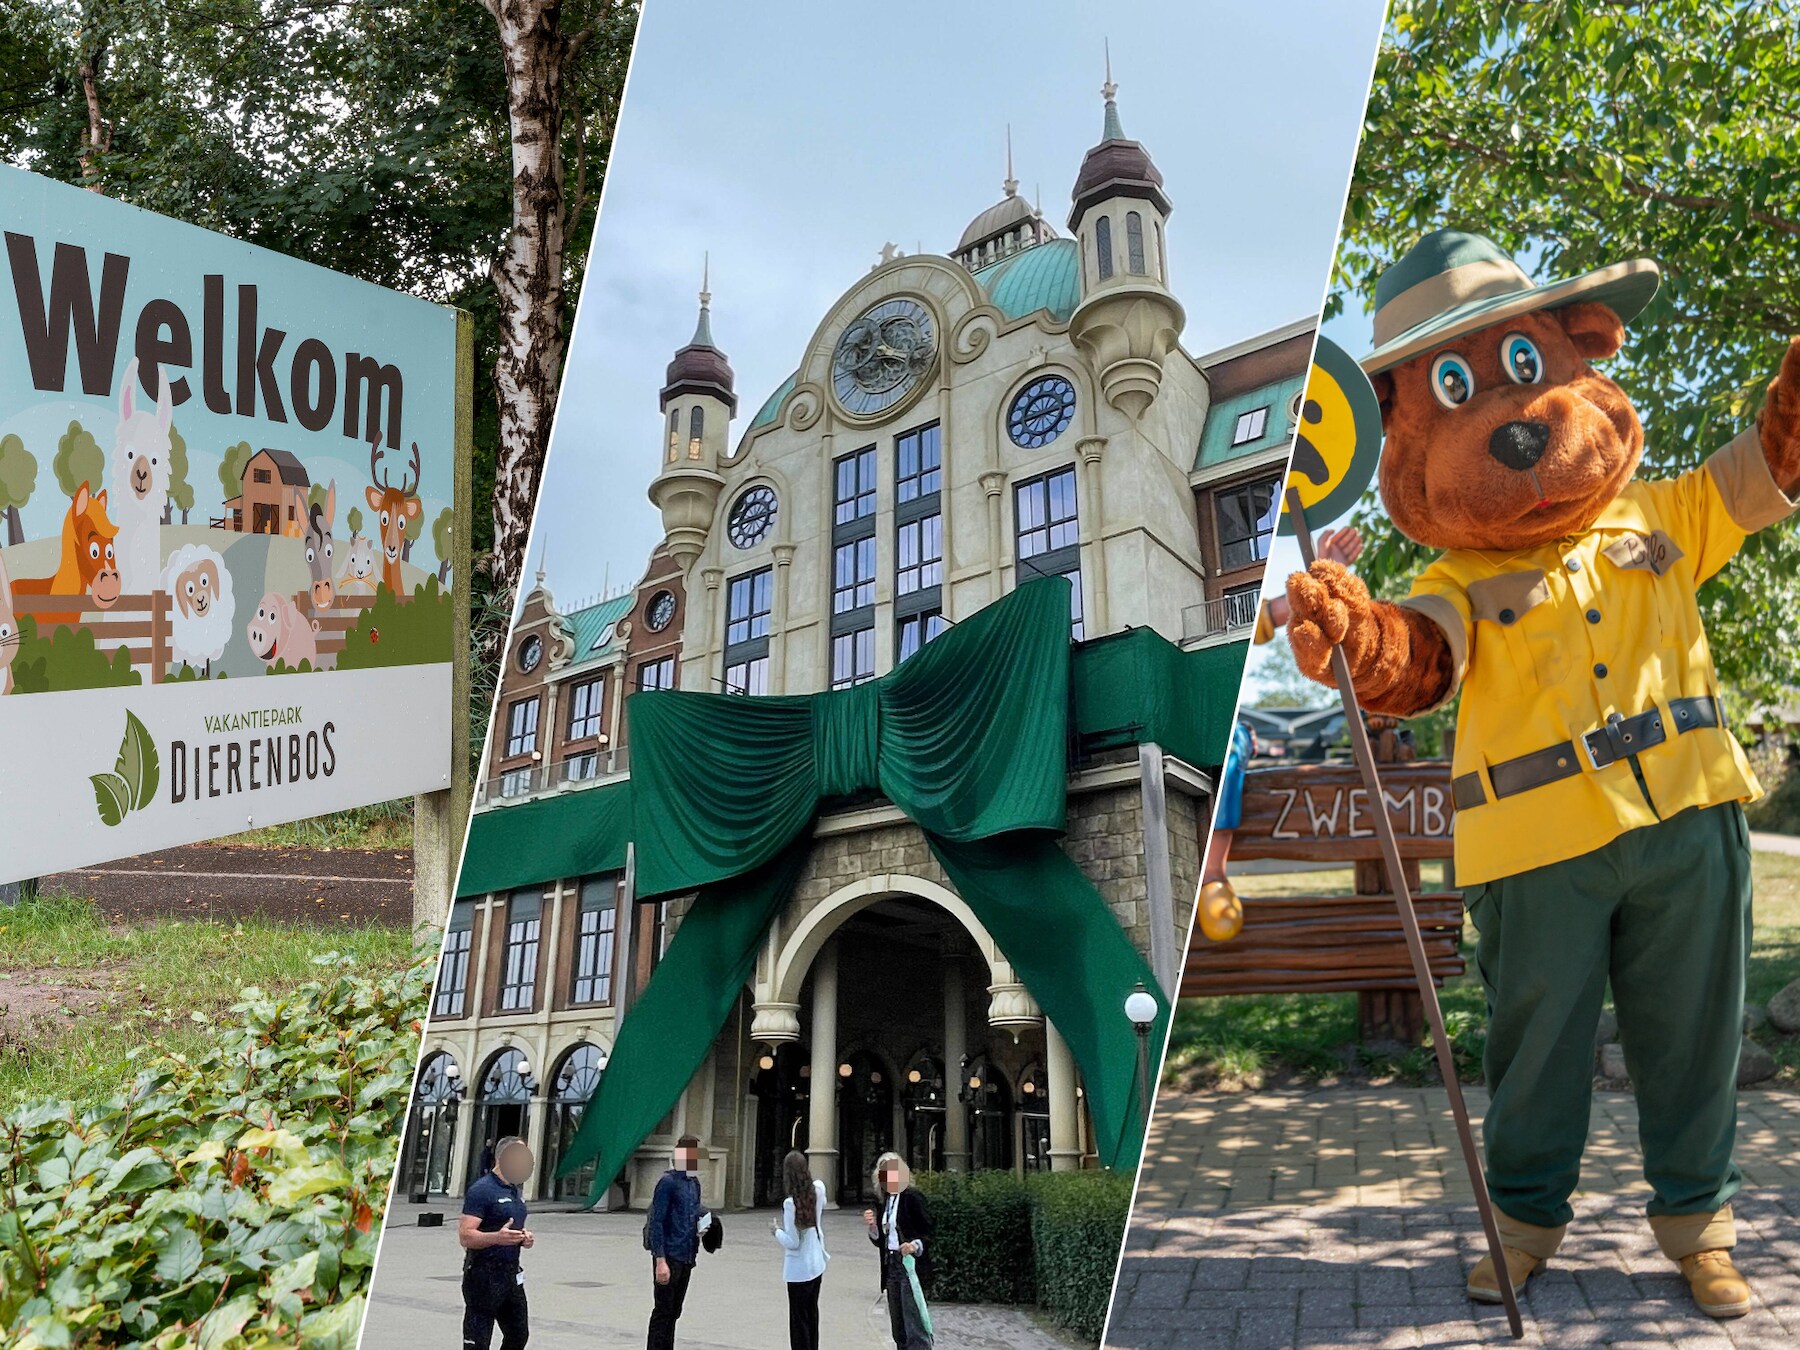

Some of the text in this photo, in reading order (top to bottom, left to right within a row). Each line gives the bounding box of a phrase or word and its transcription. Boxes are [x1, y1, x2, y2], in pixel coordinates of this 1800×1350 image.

[4, 231, 403, 450] Welkom
[204, 706, 303, 734] VAKANTIEPARK
[171, 721, 336, 804] DIERENBOS
[1269, 786, 1455, 839] ZWEMB
